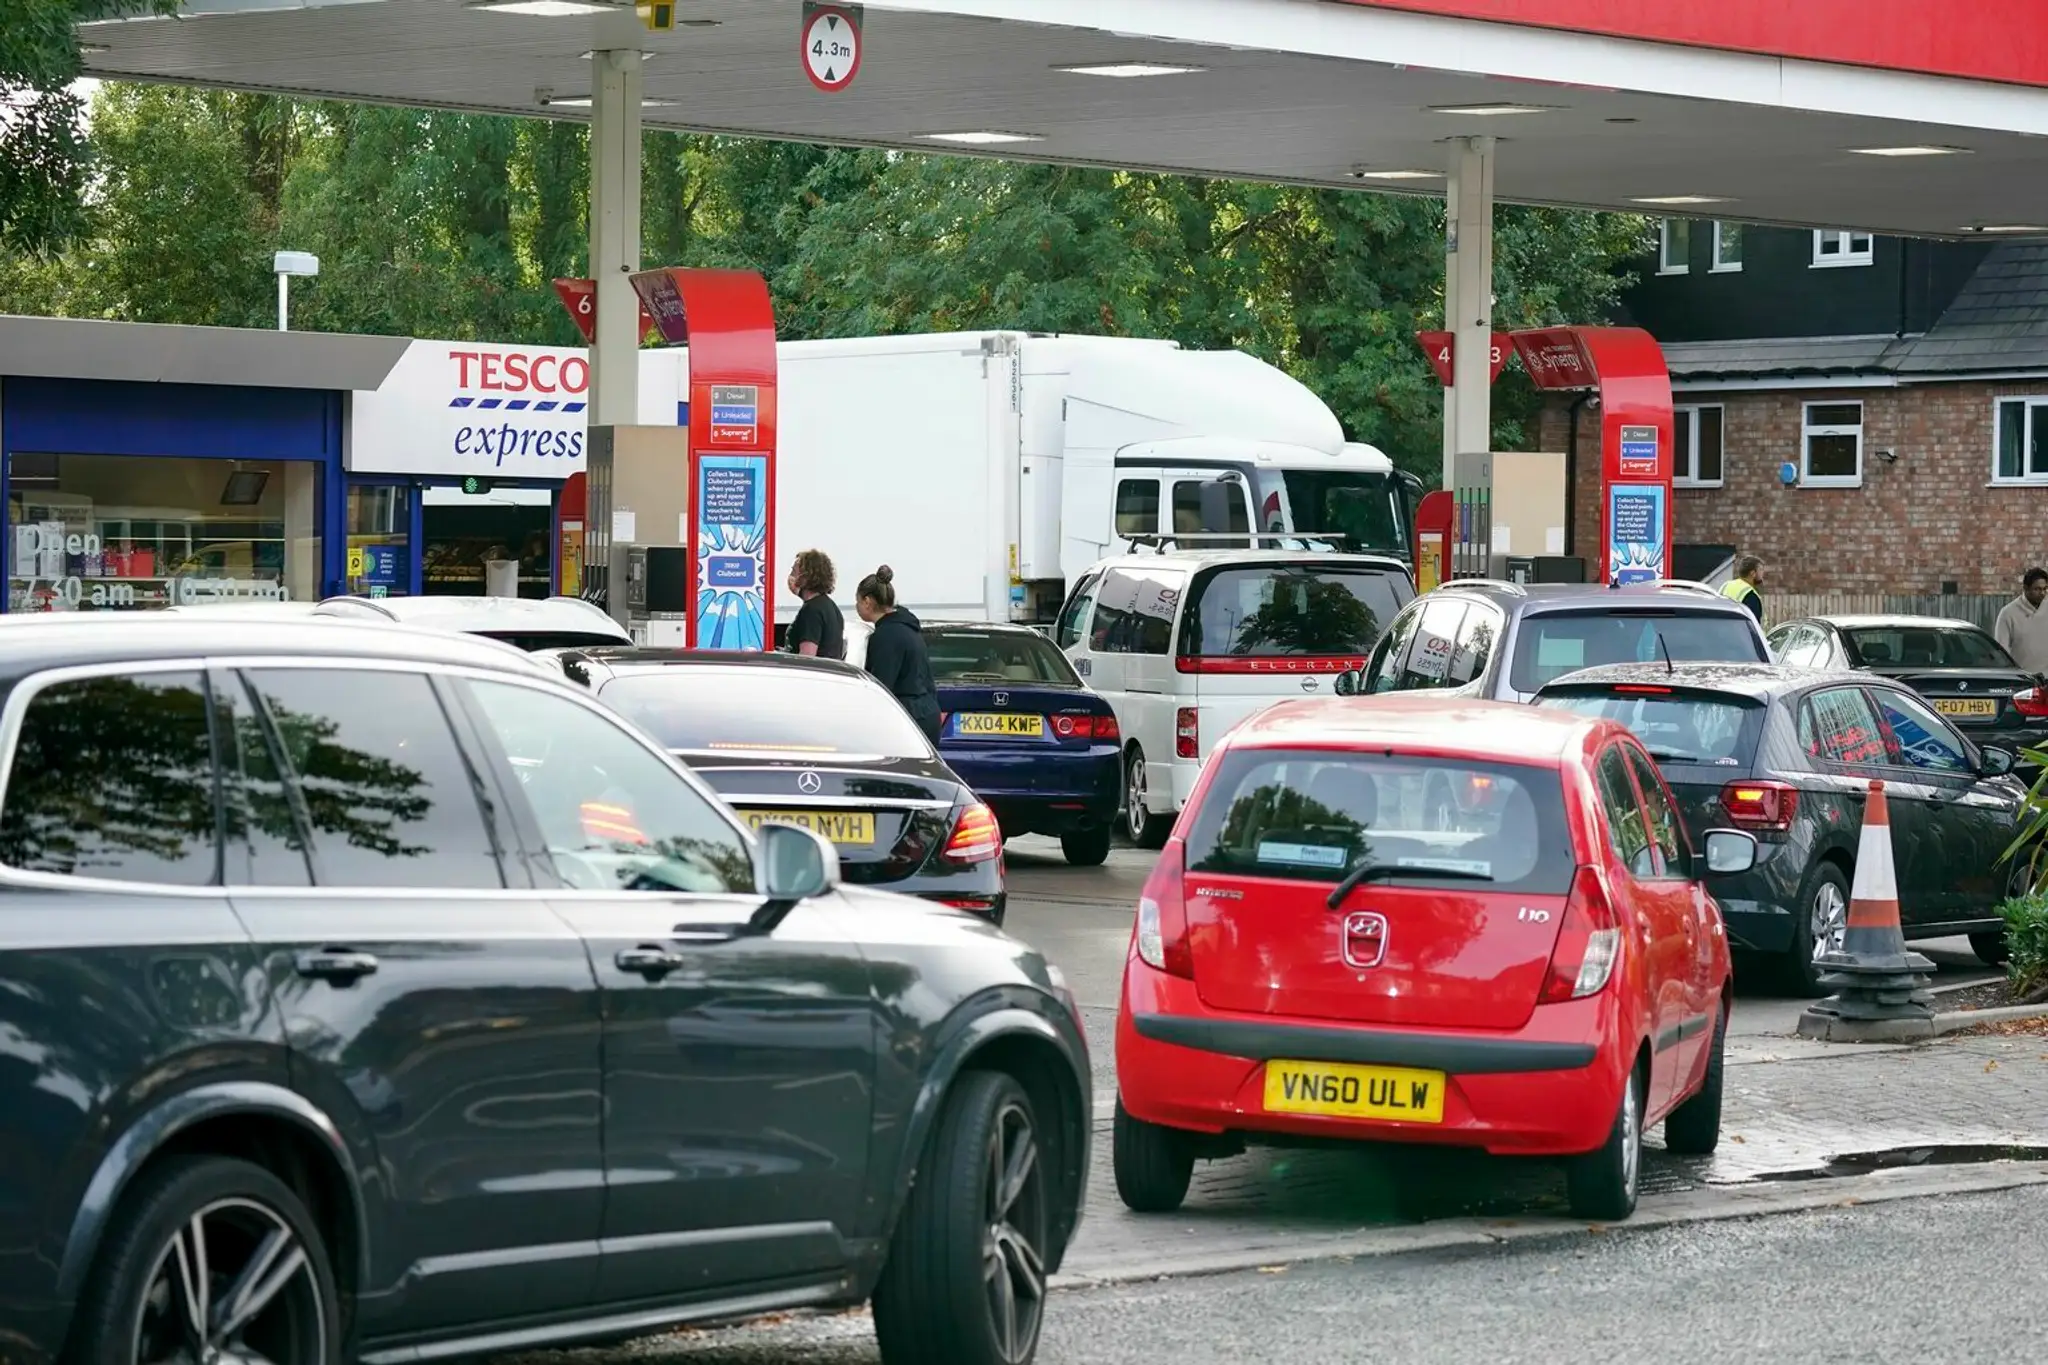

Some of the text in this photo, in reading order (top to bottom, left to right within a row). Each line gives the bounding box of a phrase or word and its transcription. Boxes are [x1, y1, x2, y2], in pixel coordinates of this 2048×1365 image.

[812, 39, 850, 57] 4.3m
[578, 294, 592, 314] 6
[1438, 347, 1450, 363] 4
[1490, 346, 1501, 363] 3
[1540, 351, 1583, 372] Synergy
[449, 351, 590, 394] TESCO
[726, 392, 746, 400] Diesel
[454, 423, 583, 467] express
[25, 524, 100, 562] Open
[716, 570, 747, 578] Clubcard
[91, 584, 134, 606] am
[1934, 701, 1992, 712] GF07 HBY
[962, 716, 1038, 732] KX04 KWF
[817, 815, 863, 839] NVH
[1282, 1072, 1429, 1110] VN60 ULW
